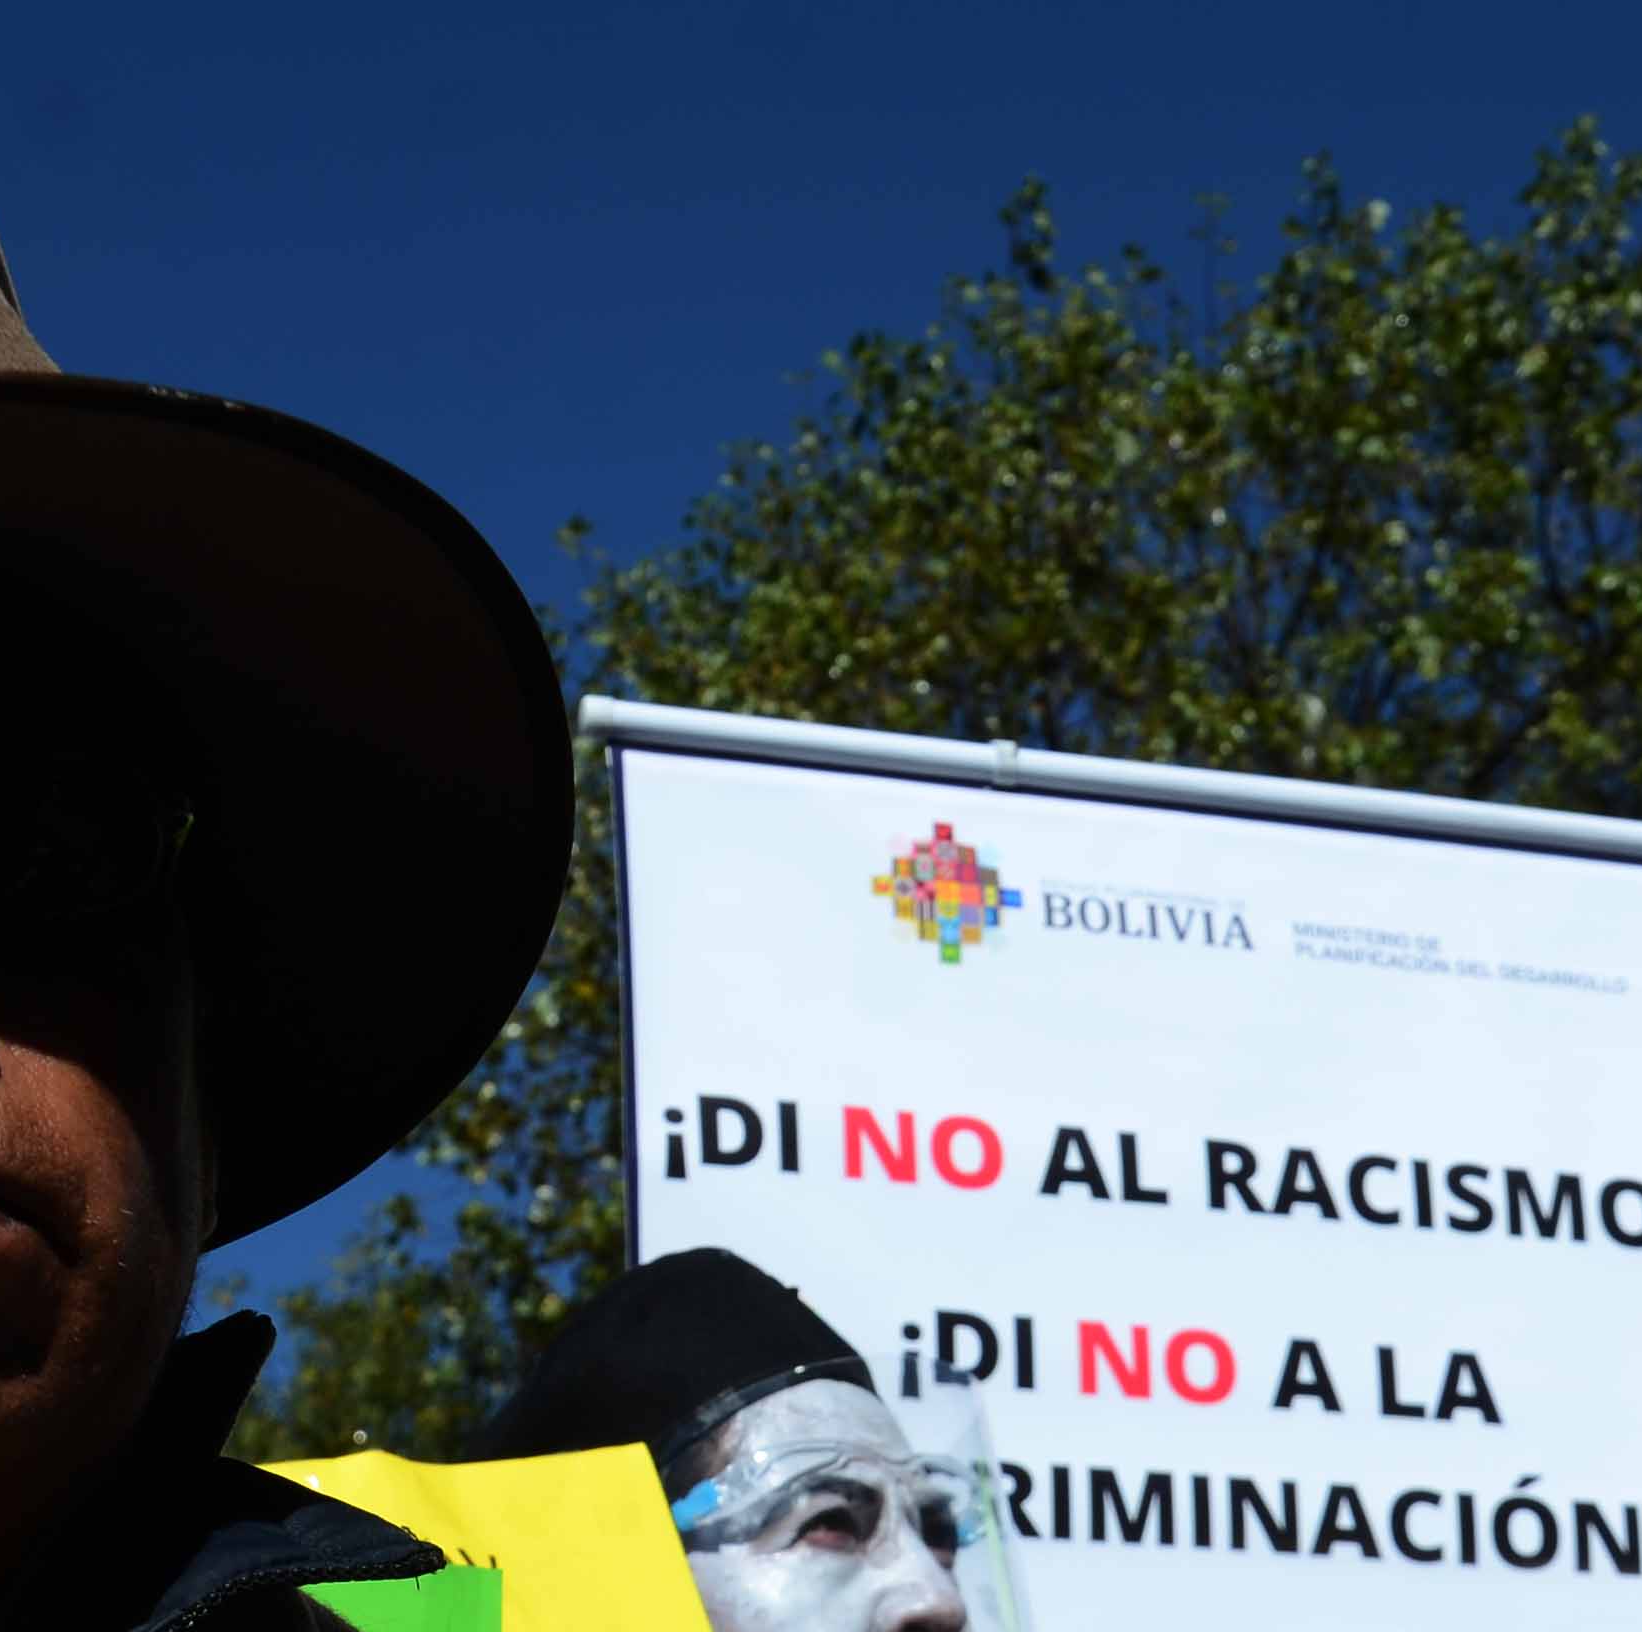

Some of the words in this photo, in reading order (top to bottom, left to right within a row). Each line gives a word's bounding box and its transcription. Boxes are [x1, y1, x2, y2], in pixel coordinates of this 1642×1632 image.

[1042, 890, 1254, 950] BOLIVIA
[663, 1095, 800, 1181] ¡DI
[843, 1107, 1004, 1191] NO
[1041, 1125, 1168, 1206] AL
[900, 1310, 1035, 1398] ¡DI
[1077, 1320, 1237, 1406] NO
[1273, 1338, 1342, 1414] A
[1377, 1346, 1503, 1425] LA
